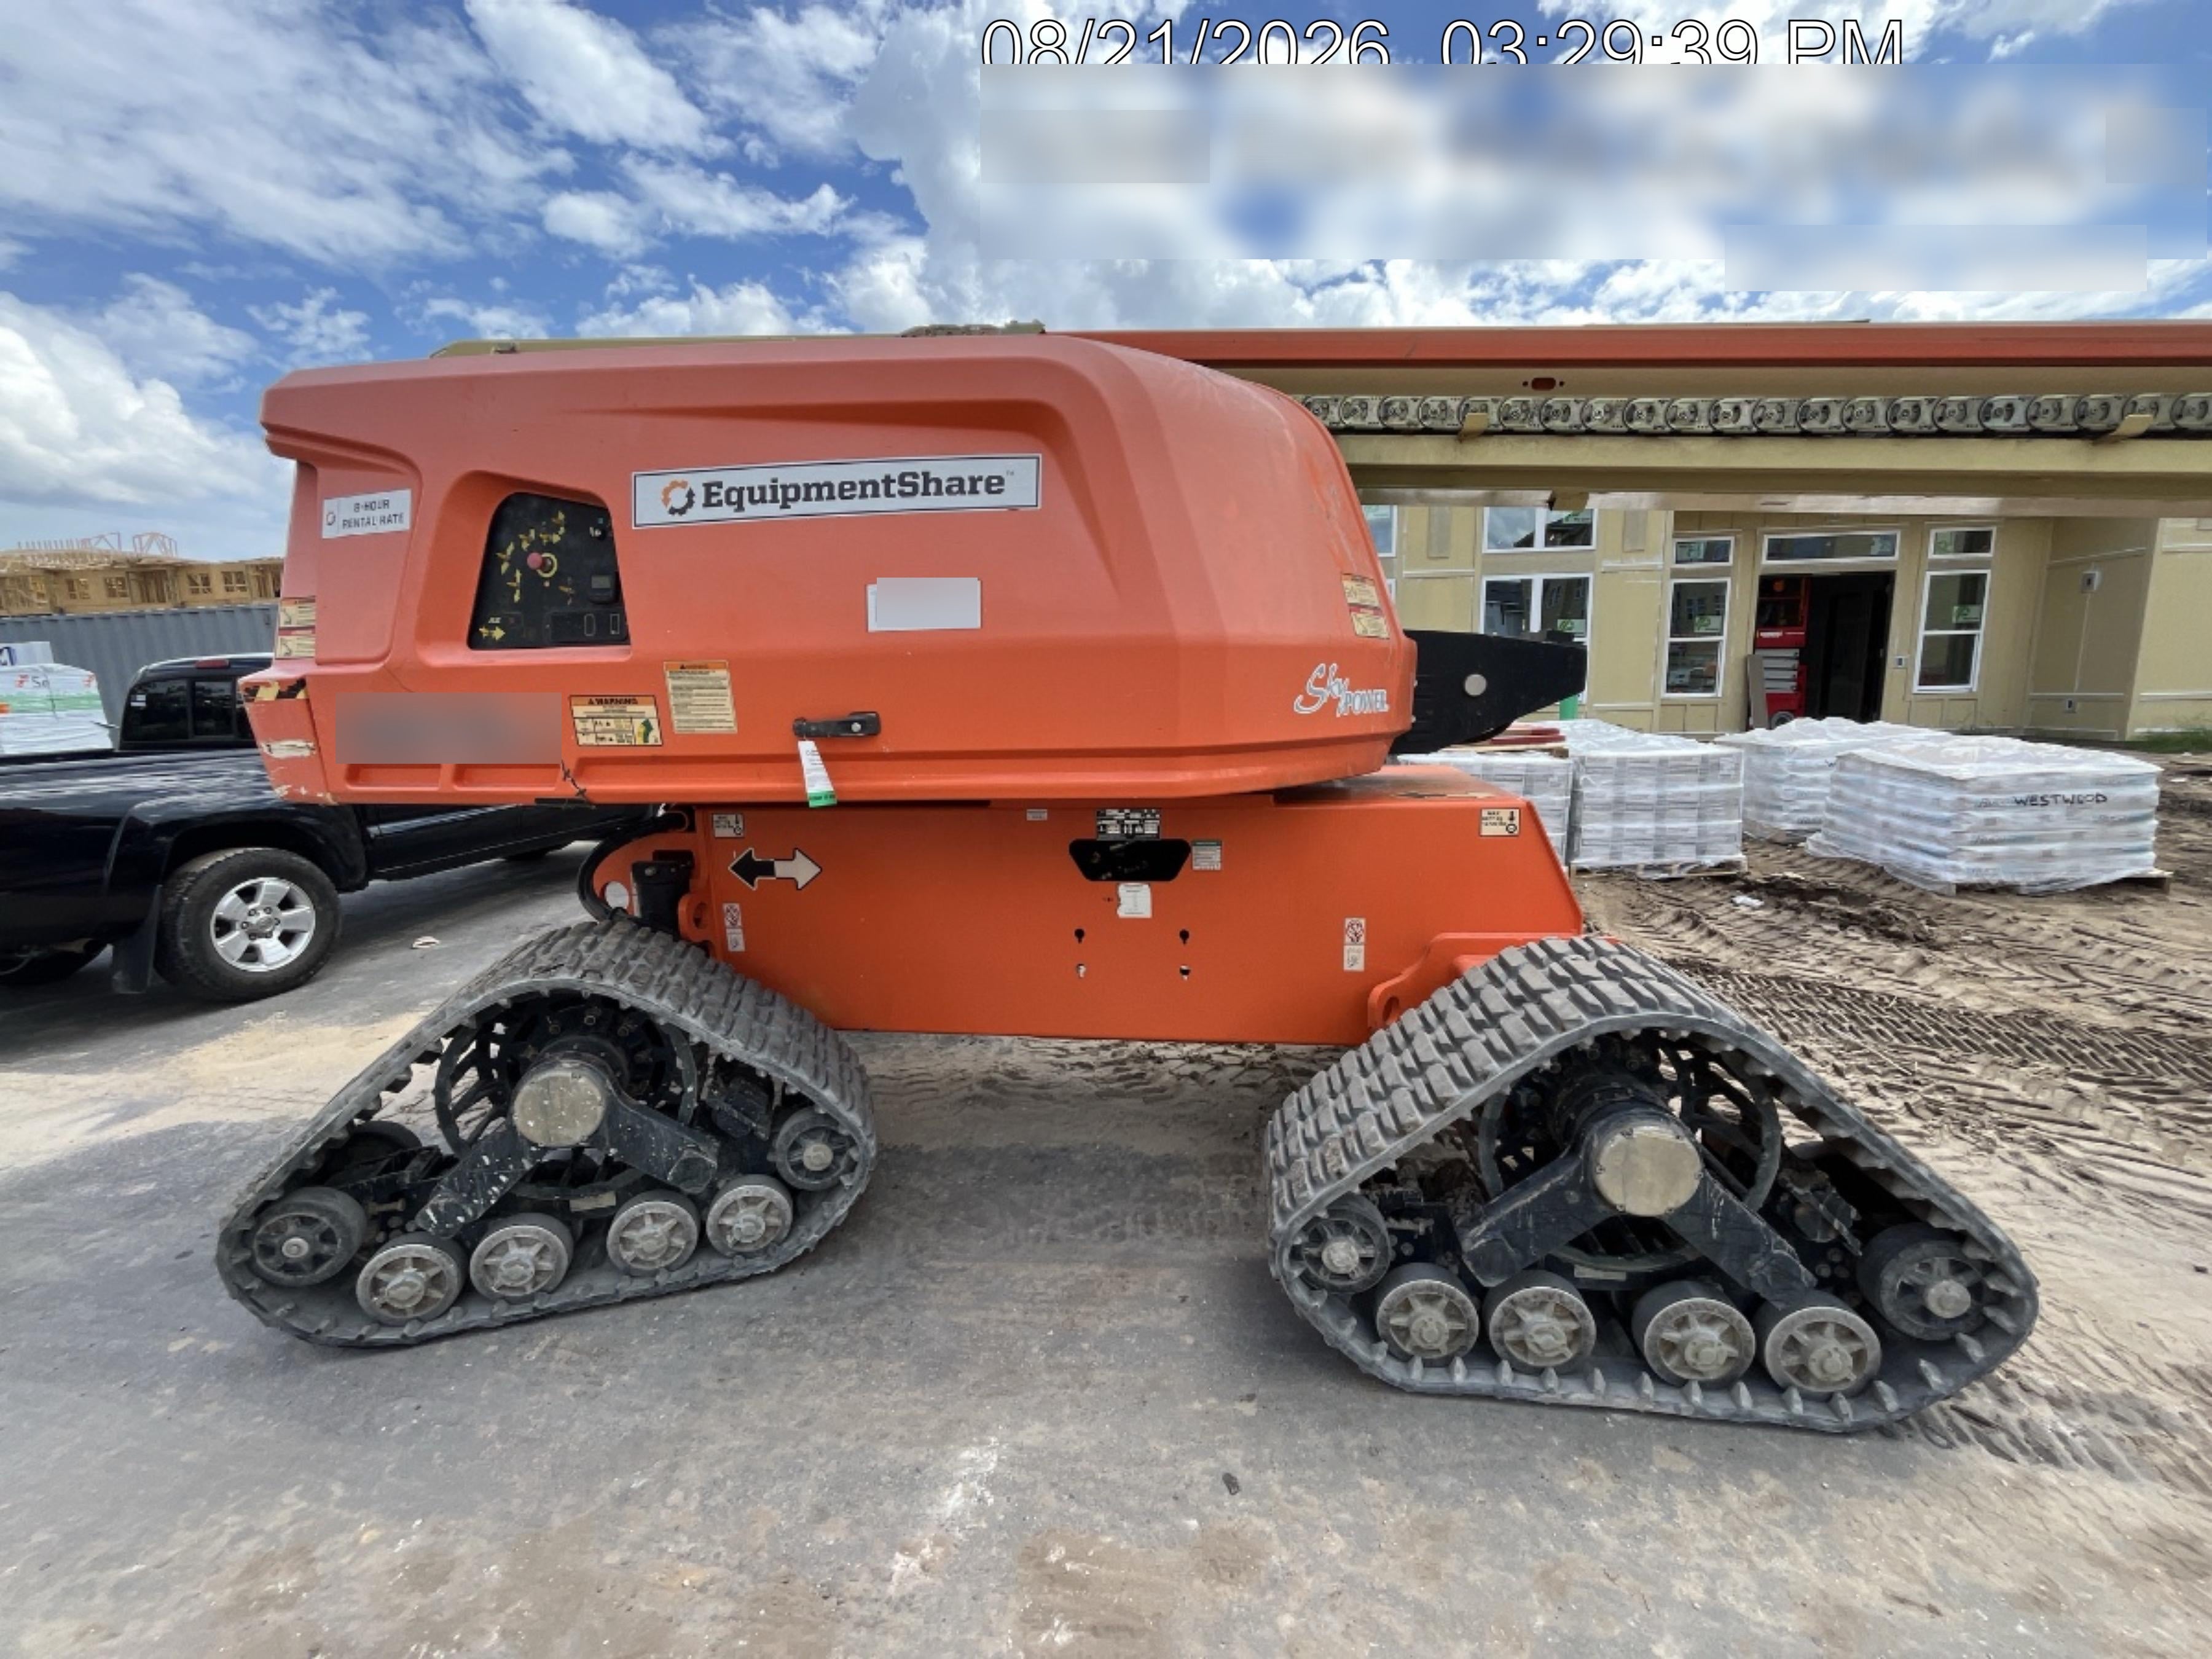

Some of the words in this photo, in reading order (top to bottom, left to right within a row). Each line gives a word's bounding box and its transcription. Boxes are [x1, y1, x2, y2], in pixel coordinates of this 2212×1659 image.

[701, 471, 1006, 512] EquipmentShare
[379, 512, 404, 525] RATE
[2014, 793, 2108, 807] WESTWOOD
